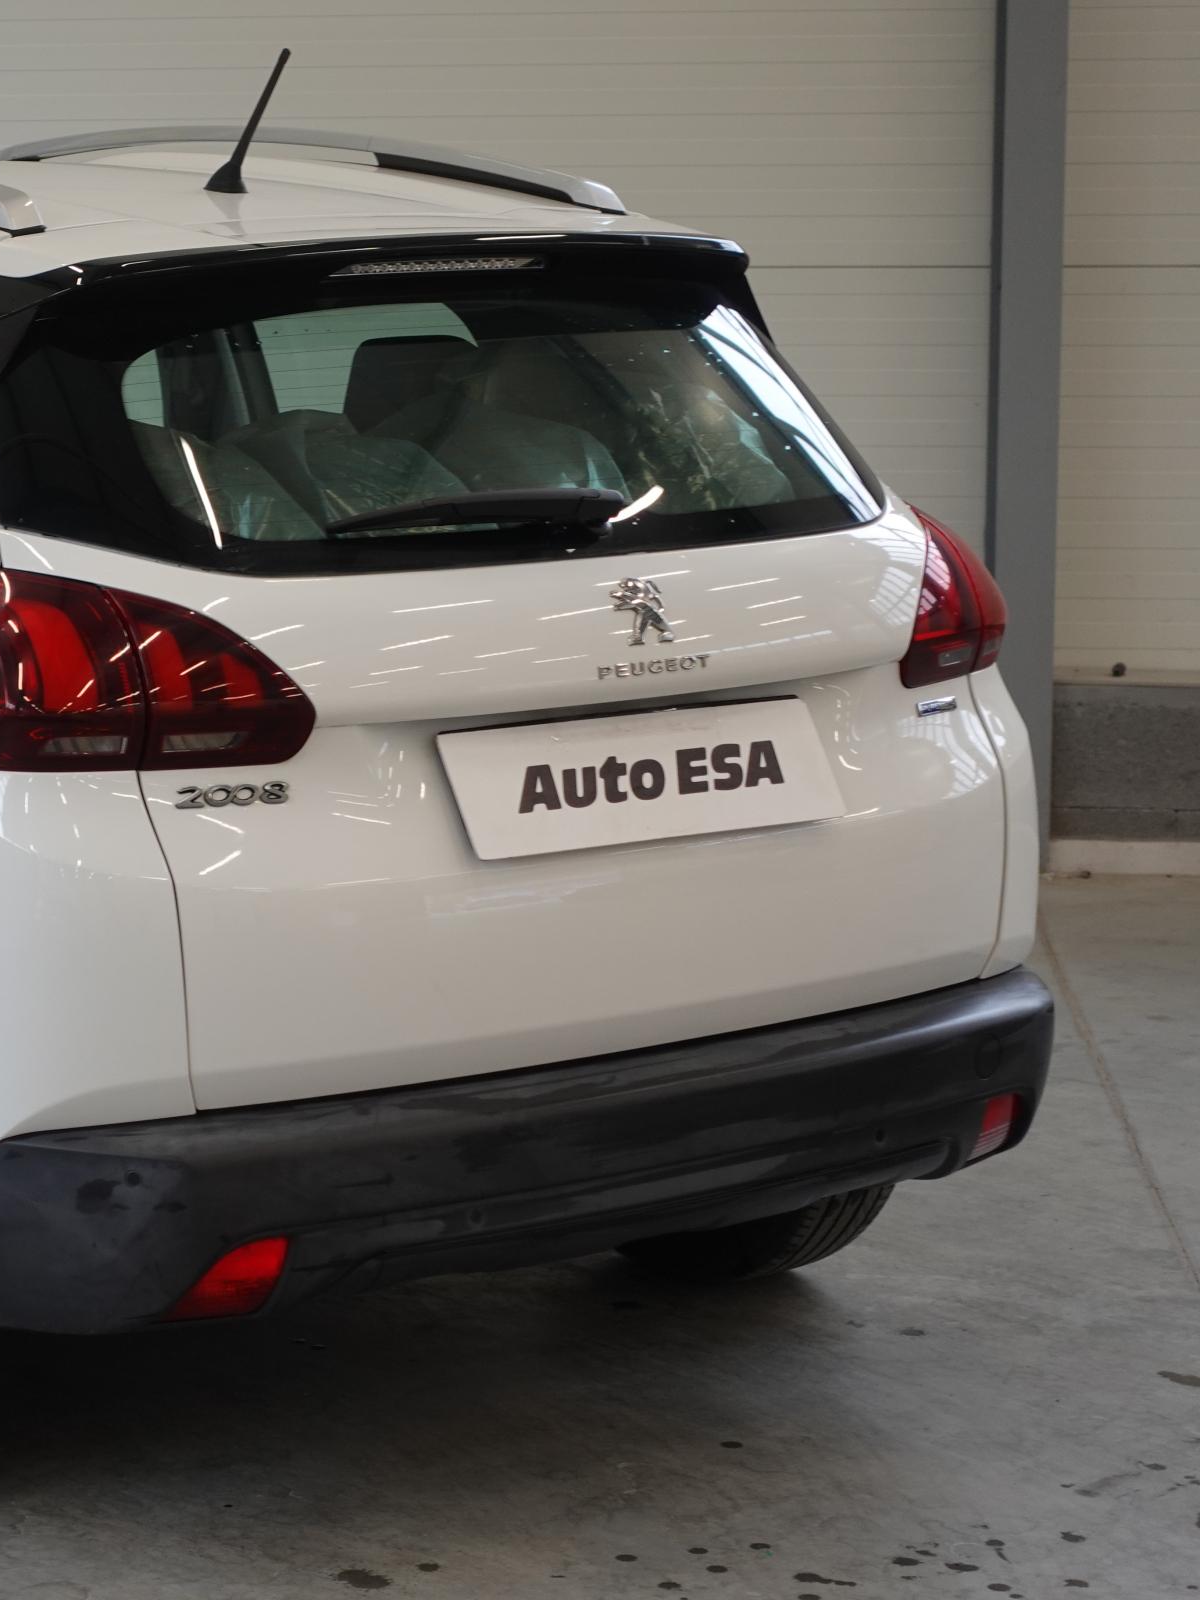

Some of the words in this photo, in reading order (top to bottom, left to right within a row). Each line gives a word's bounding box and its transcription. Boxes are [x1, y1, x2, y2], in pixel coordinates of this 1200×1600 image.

[597, 653, 711, 680] PEUGEOT
[518, 756, 665, 814] Auto
[676, 740, 784, 795] ESA
[174, 780, 289, 810] 2008
